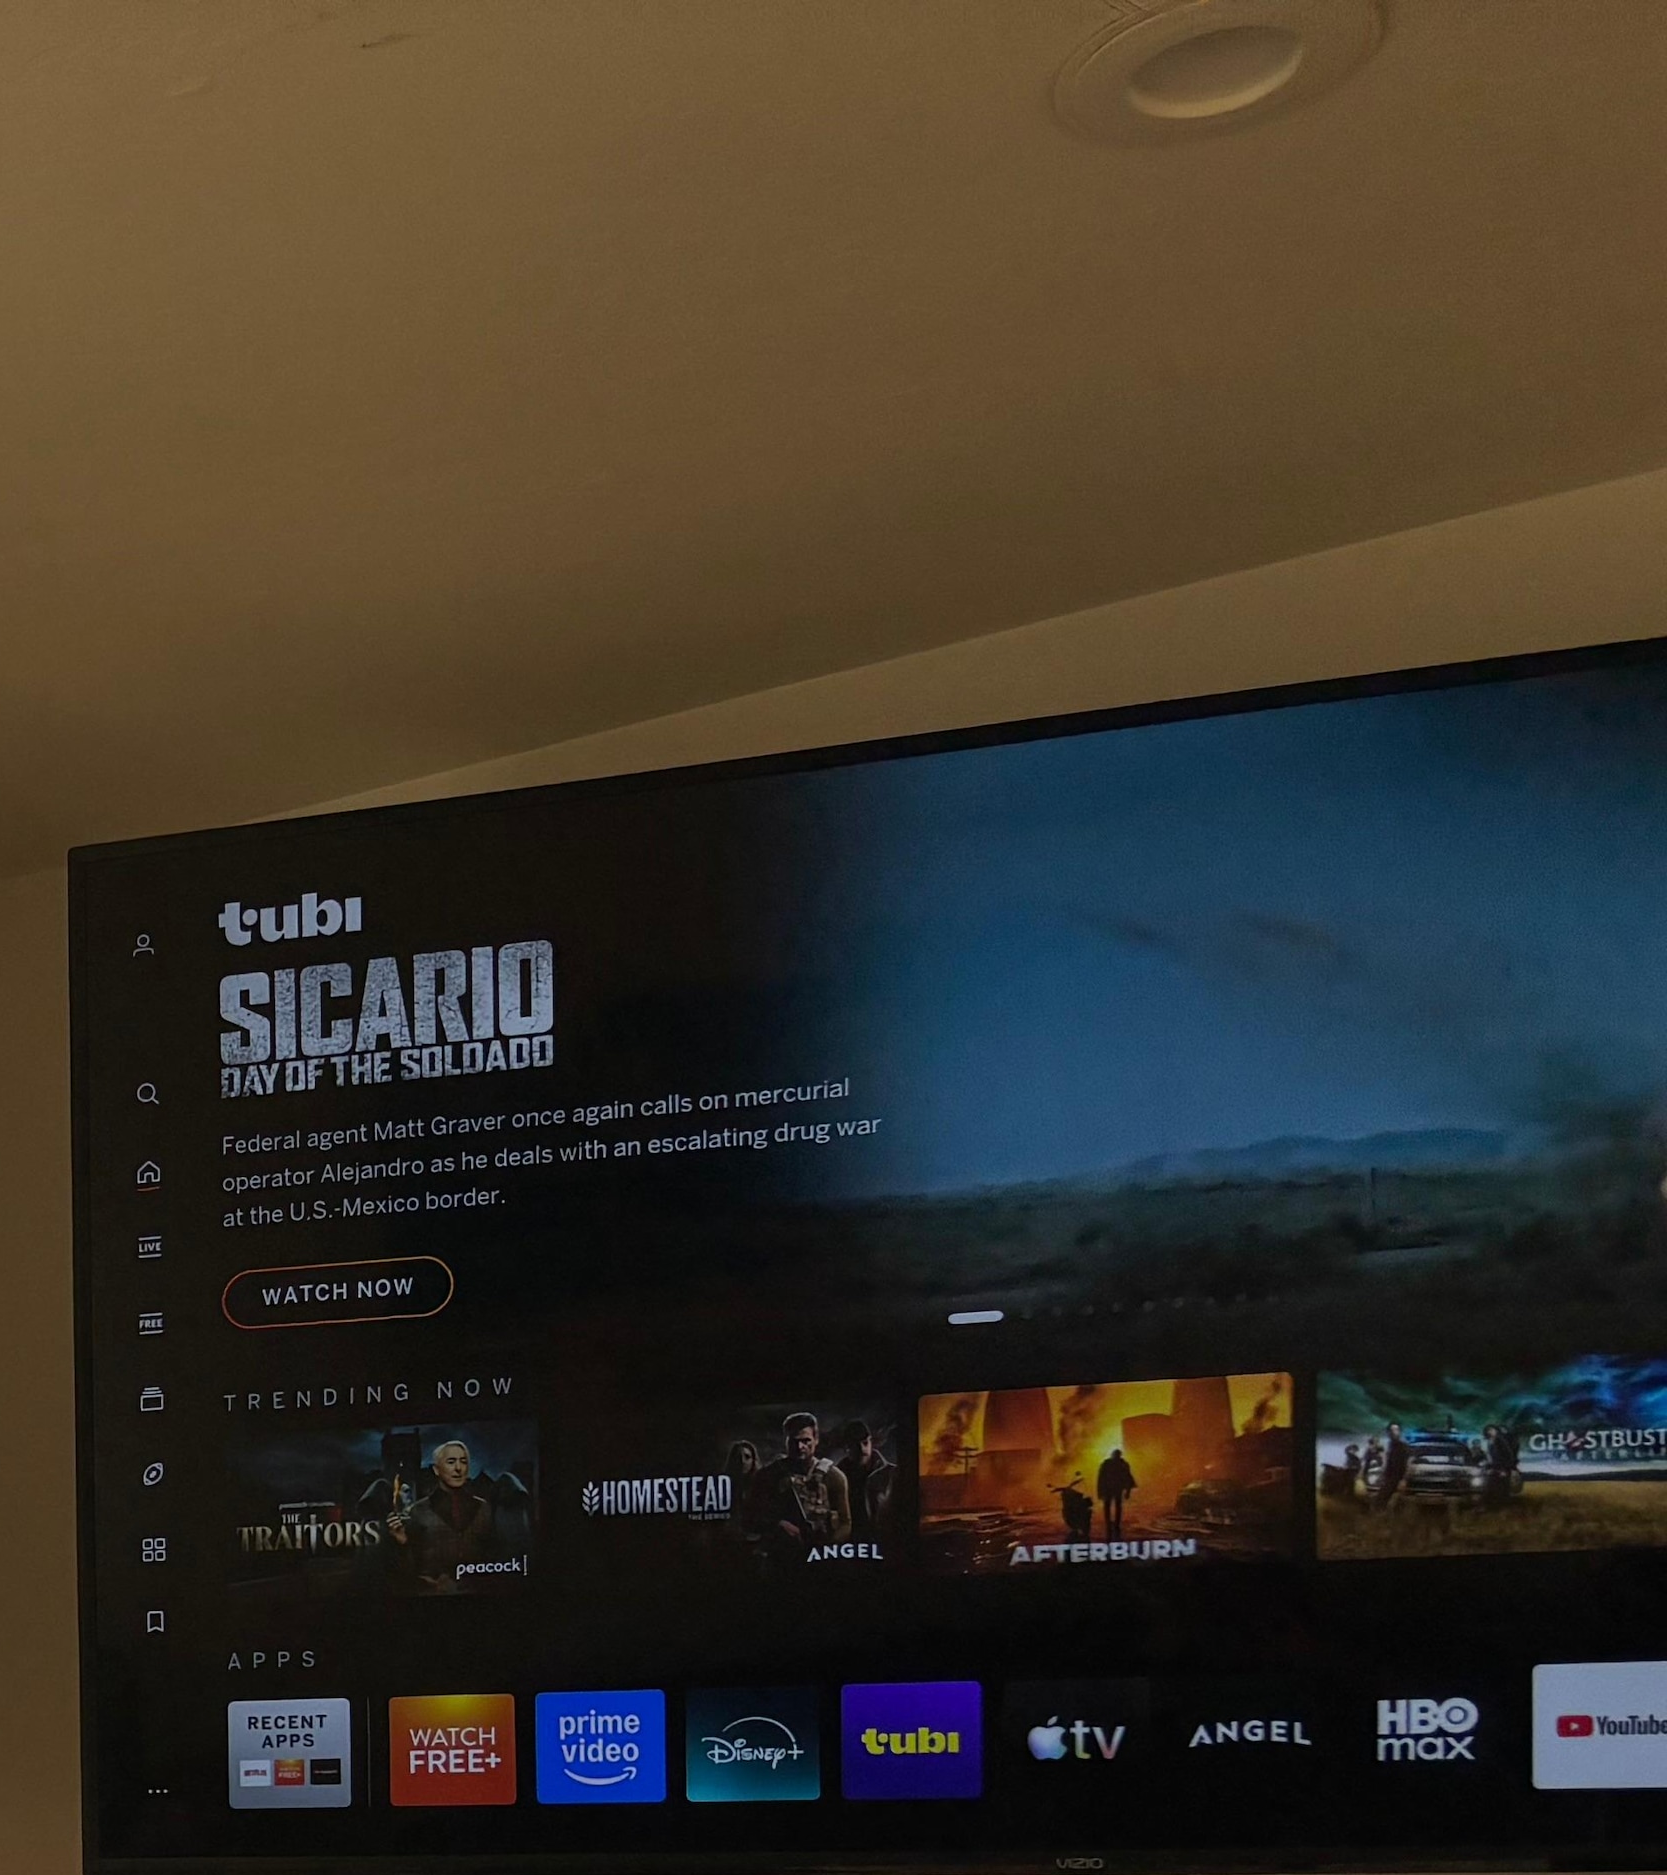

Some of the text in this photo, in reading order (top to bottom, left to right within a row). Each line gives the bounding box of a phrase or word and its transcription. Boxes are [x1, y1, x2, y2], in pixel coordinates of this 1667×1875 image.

[219, 893, 362, 946] tubi
[220, 939, 554, 1066] SICARIO
[221, 1034, 554, 1099] DAY OF THE SOLDADO
[222, 1077, 850, 1155] Federal agent Matt Graver once again calls on mercurial
[222, 1117, 882, 1195] operator Alejandro as he deals with an escalating drug war
[222, 1188, 506, 1228] at the U.S.-Mexico border.
[139, 1241, 161, 1253] LIVE
[262, 1277, 414, 1306] WATCH NOW
[139, 1318, 163, 1329] FREE
[223, 1376, 515, 1412] TRENDING NOW
[601, 1473, 732, 1516] HOMESTEAD
[281, 1512, 301, 1525] THE
[236, 1519, 382, 1554] TRAITORS
[806, 1542, 884, 1563] ANGEL
[1008, 1537, 1196, 1567] AFTERBURN
[455, 1557, 521, 1581] peacock
[227, 1650, 317, 1671] APPS
[248, 1714, 328, 1730] RECENT
[559, 1710, 641, 1743] prime
[1377, 1697, 1479, 1735] HBO
[261, 1733, 315, 1748] APPS
[409, 1727, 497, 1748] WATCH
[860, 1726, 961, 1756] tubi
[1069, 1719, 1126, 1761] tv
[1188, 1720, 1313, 1747] ANGEL
[409, 1748, 502, 1775] FREE+
[560, 1738, 640, 1764] video
[1377, 1735, 1475, 1762] max
